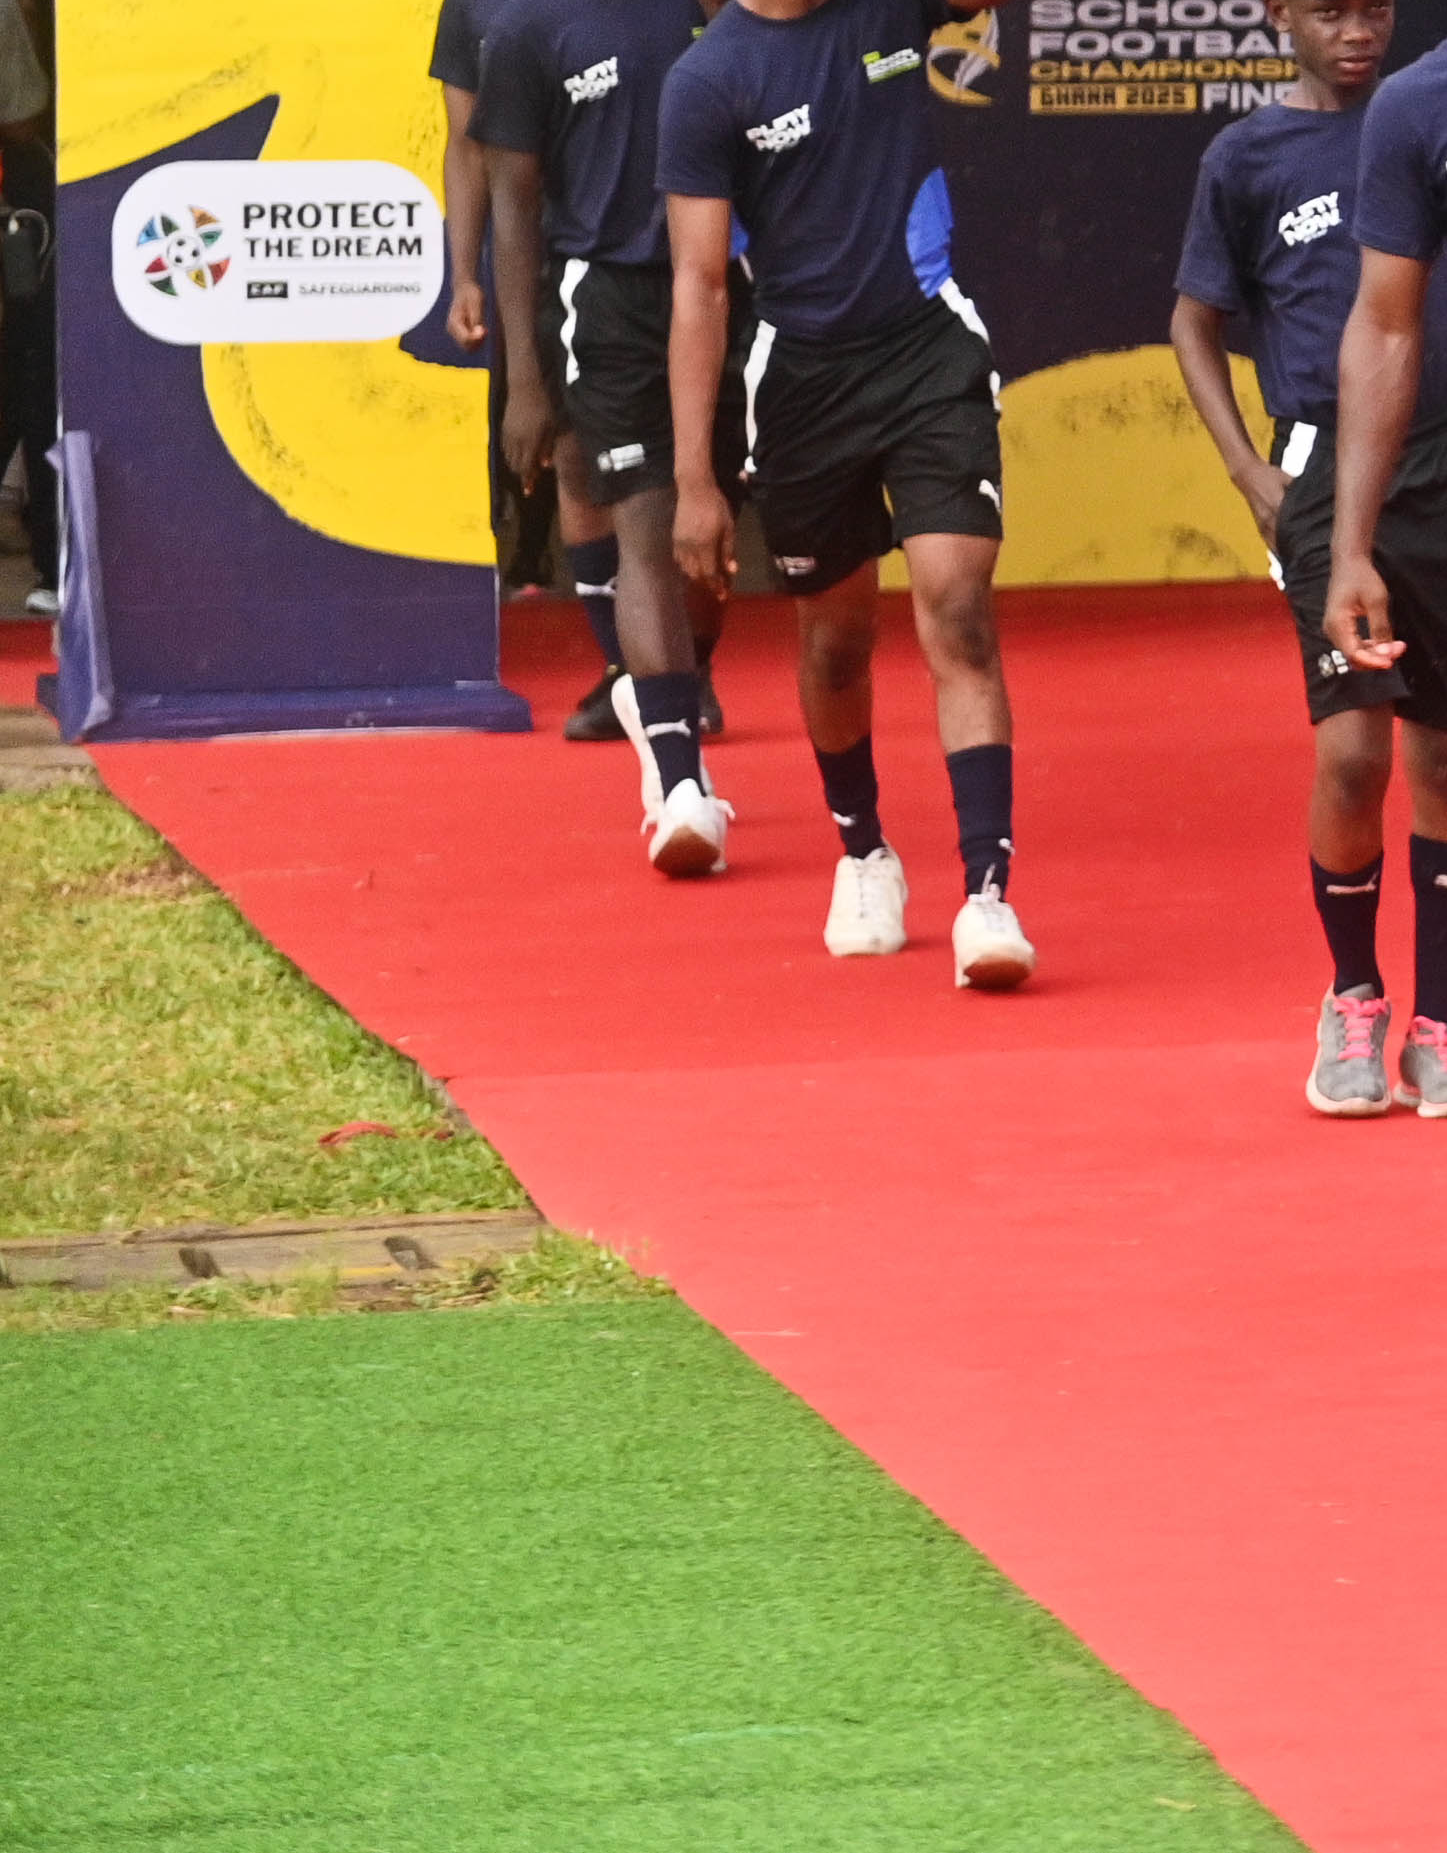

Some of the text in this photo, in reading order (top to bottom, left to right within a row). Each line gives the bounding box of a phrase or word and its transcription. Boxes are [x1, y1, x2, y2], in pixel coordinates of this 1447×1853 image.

[1028, 29, 1297, 59] FOOTBAL
[1029, 59, 1299, 81] CHAMPIONS
[1125, 84, 1187, 106] 2025
[1202, 81, 1298, 114] FIN
[242, 201, 422, 230] PROTECT
[245, 235, 423, 258] THE DREAM
